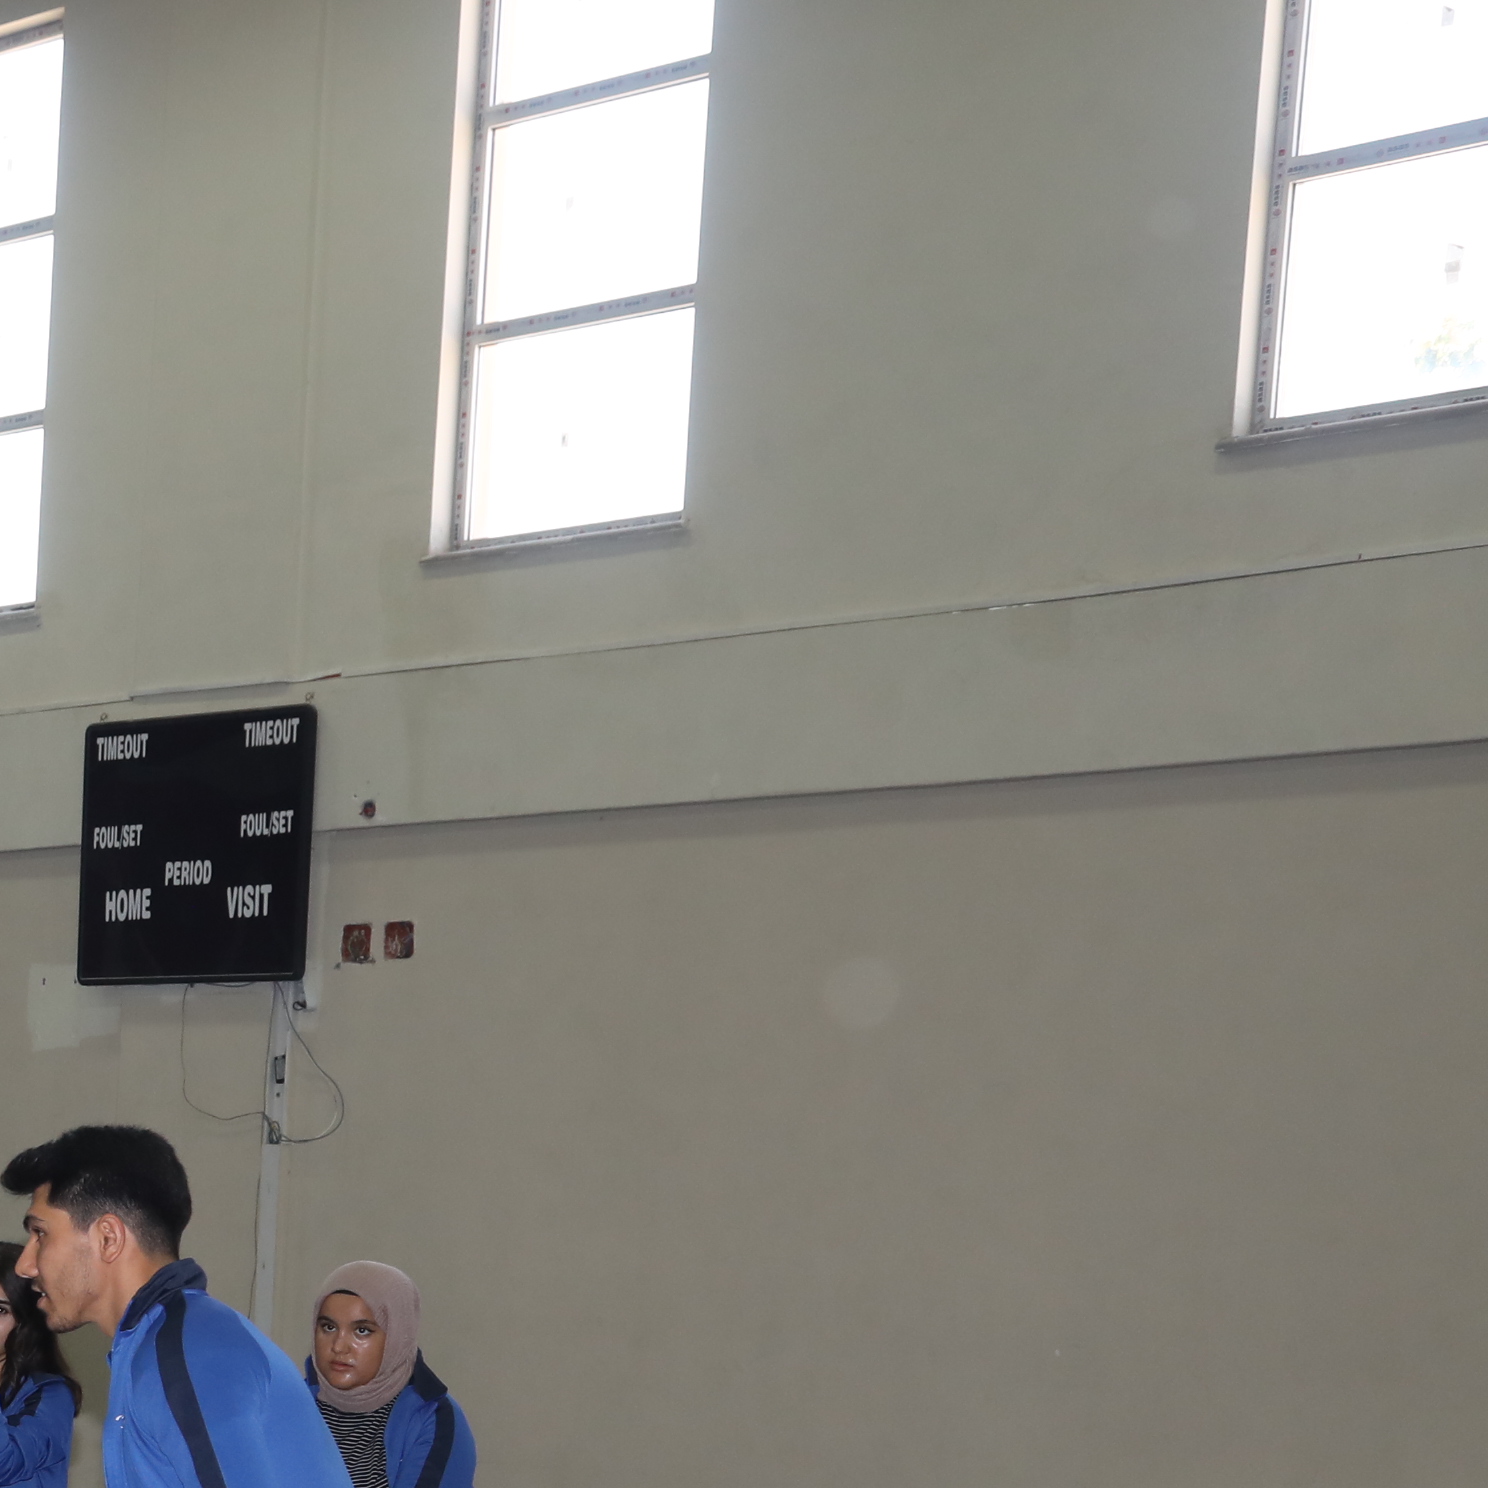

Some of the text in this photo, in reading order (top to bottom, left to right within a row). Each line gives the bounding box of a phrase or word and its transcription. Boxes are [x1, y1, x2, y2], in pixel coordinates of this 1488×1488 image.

[243, 717, 300, 748] TIMEOUT
[96, 733, 149, 762] TIMEOUT
[93, 824, 143, 850] FOUL/SET
[240, 810, 294, 838] FOUL/SET
[165, 860, 212, 886] PERIOD
[105, 888, 152, 922] HOME
[226, 884, 272, 918] VISIT
